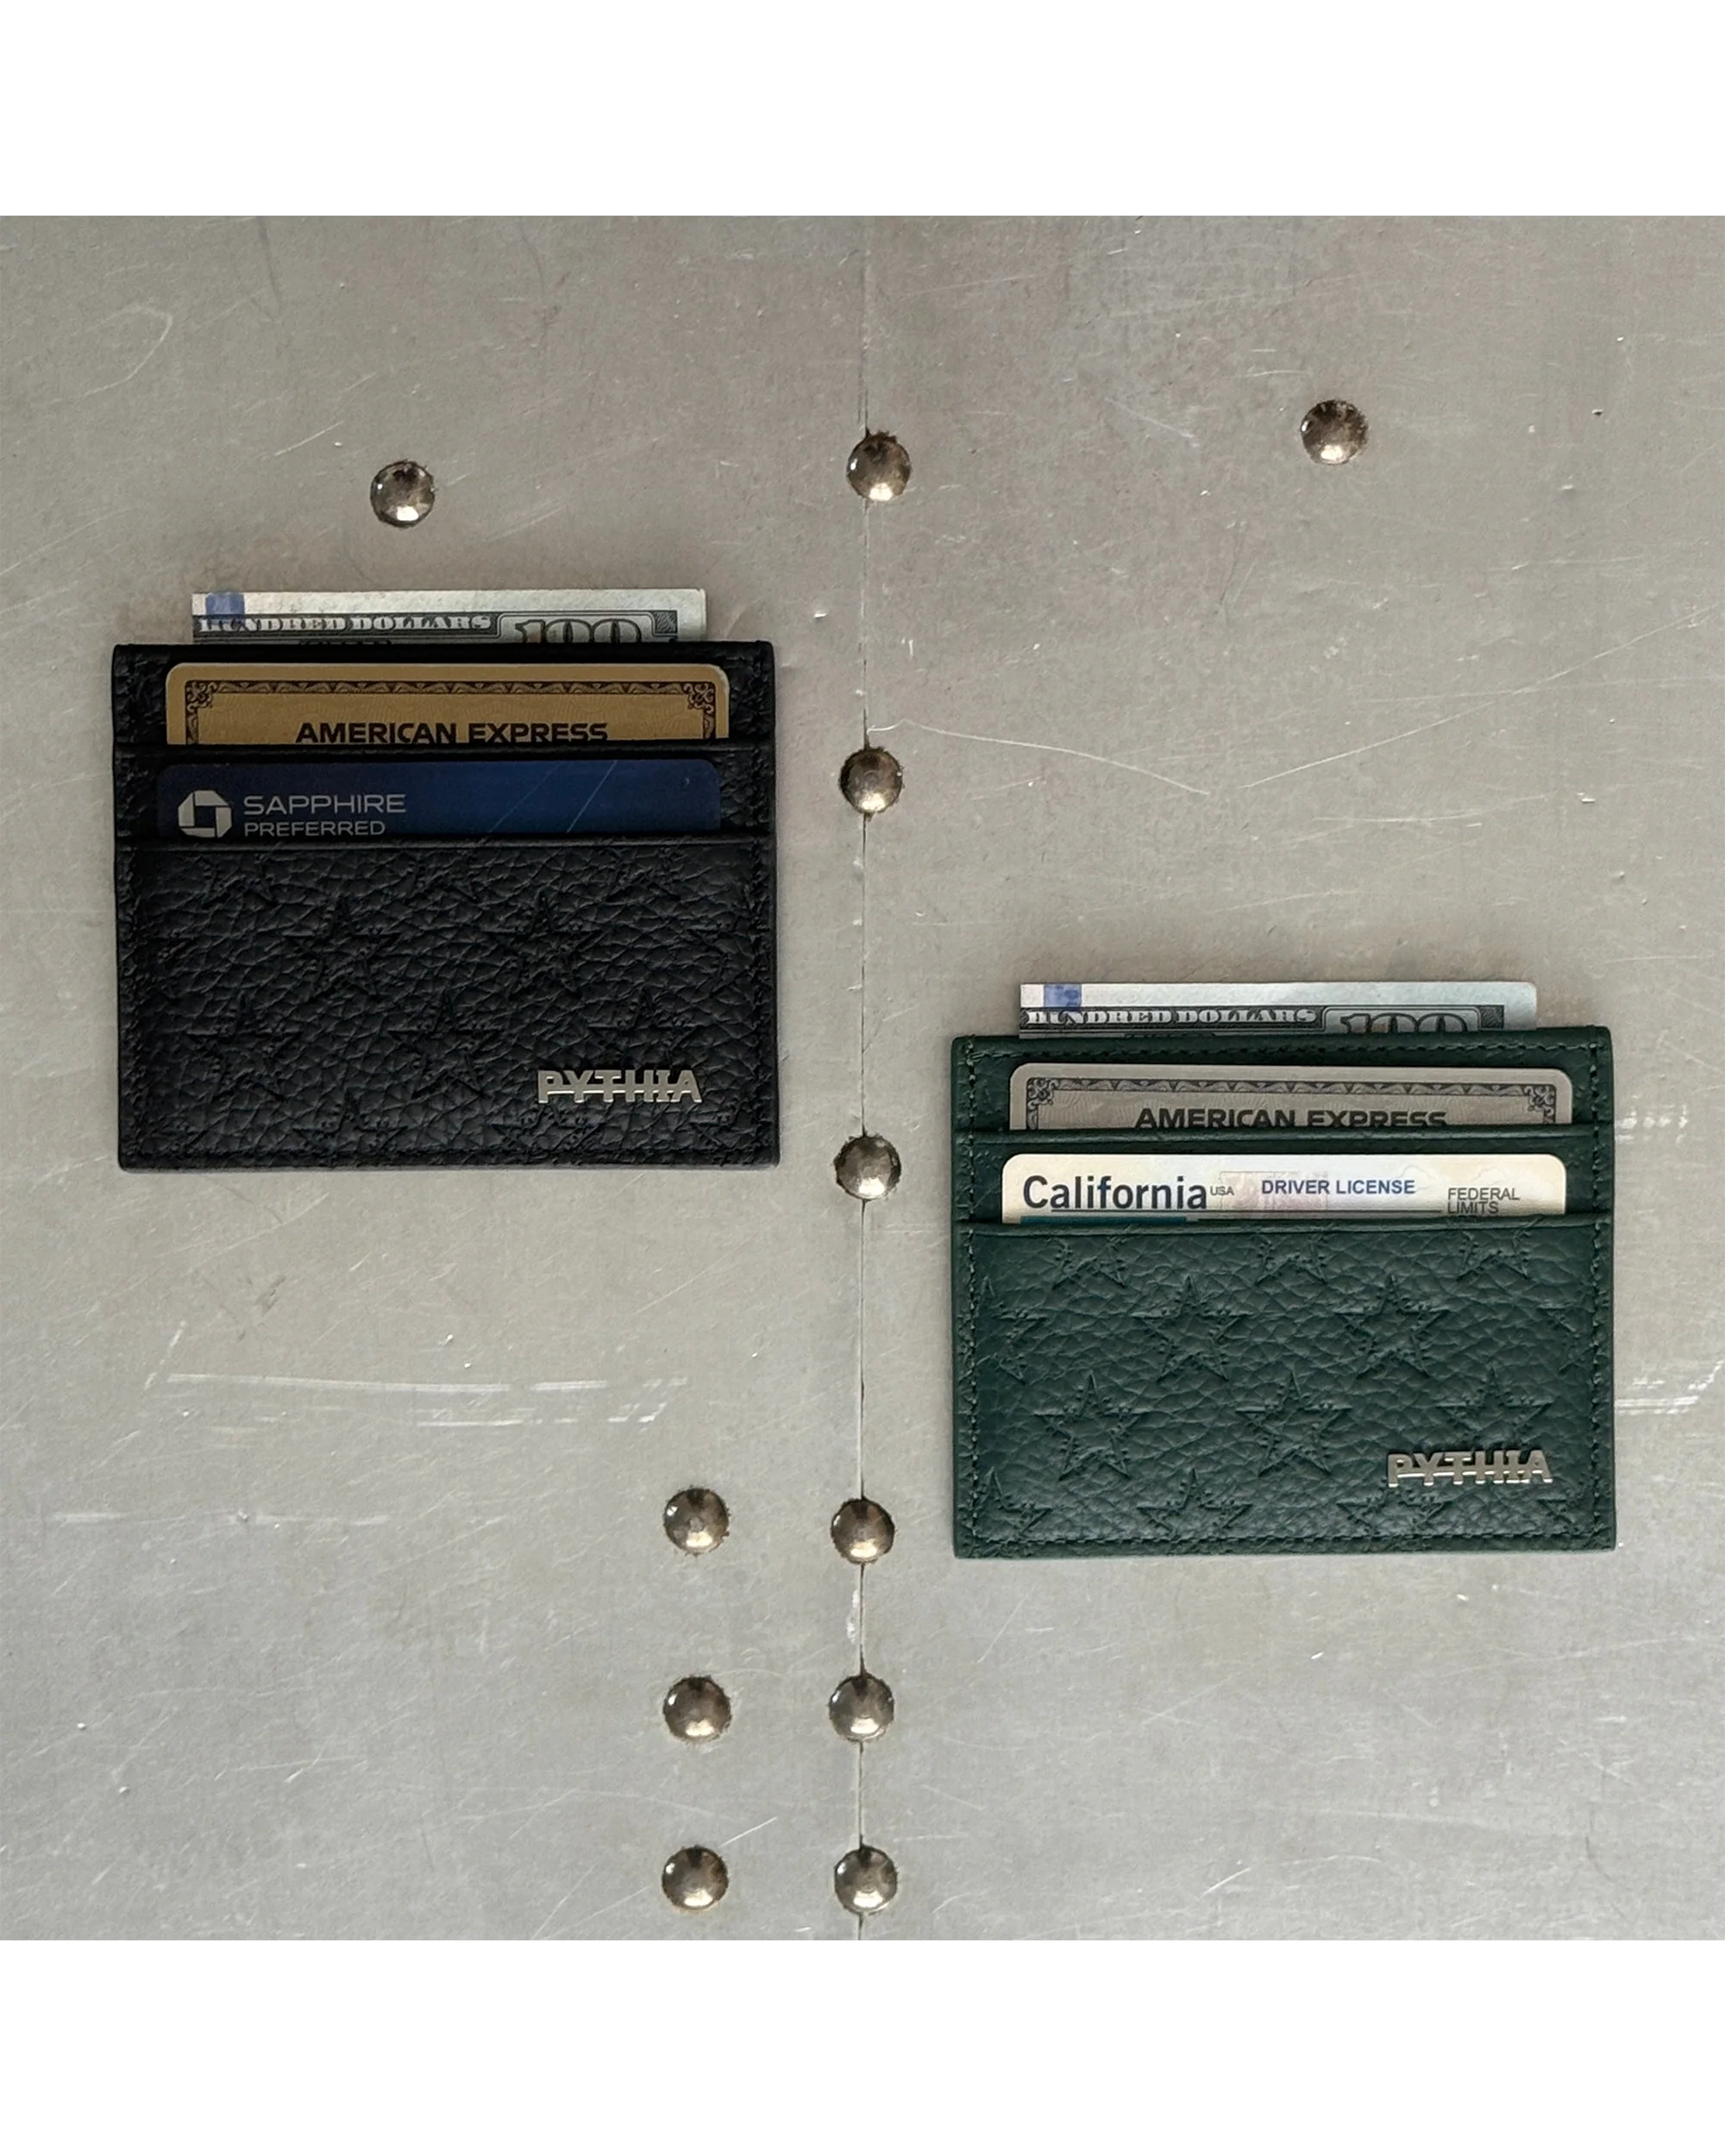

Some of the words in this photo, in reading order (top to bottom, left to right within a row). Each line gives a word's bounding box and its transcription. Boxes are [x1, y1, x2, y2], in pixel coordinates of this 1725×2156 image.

[349, 615, 492, 632] DOLLARS
[515, 618, 643, 643] 100
[295, 722, 457, 743] AMERICAN
[468, 723, 608, 743] EXPRESS
[243, 793, 407, 816] SAPPHIRE
[244, 820, 386, 837] PREFERRED
[1176, 1007, 1317, 1025] DOLLARS
[1339, 1012, 1469, 1034] 100
[537, 1069, 703, 1104] PYTHIA
[1133, 1107, 1295, 1129] AMERICAN
[1307, 1110, 1447, 1128] EXPRESS
[1023, 1175, 1208, 1210] California
[1210, 1186, 1234, 1197] USA
[1261, 1179, 1330, 1195] DRIVER
[1336, 1179, 1416, 1195] LICENSE
[1447, 1187, 1521, 1201] FEDERAL
[1447, 1200, 1500, 1214] LIMITS
[1388, 1450, 1552, 1488] PYTHIA
